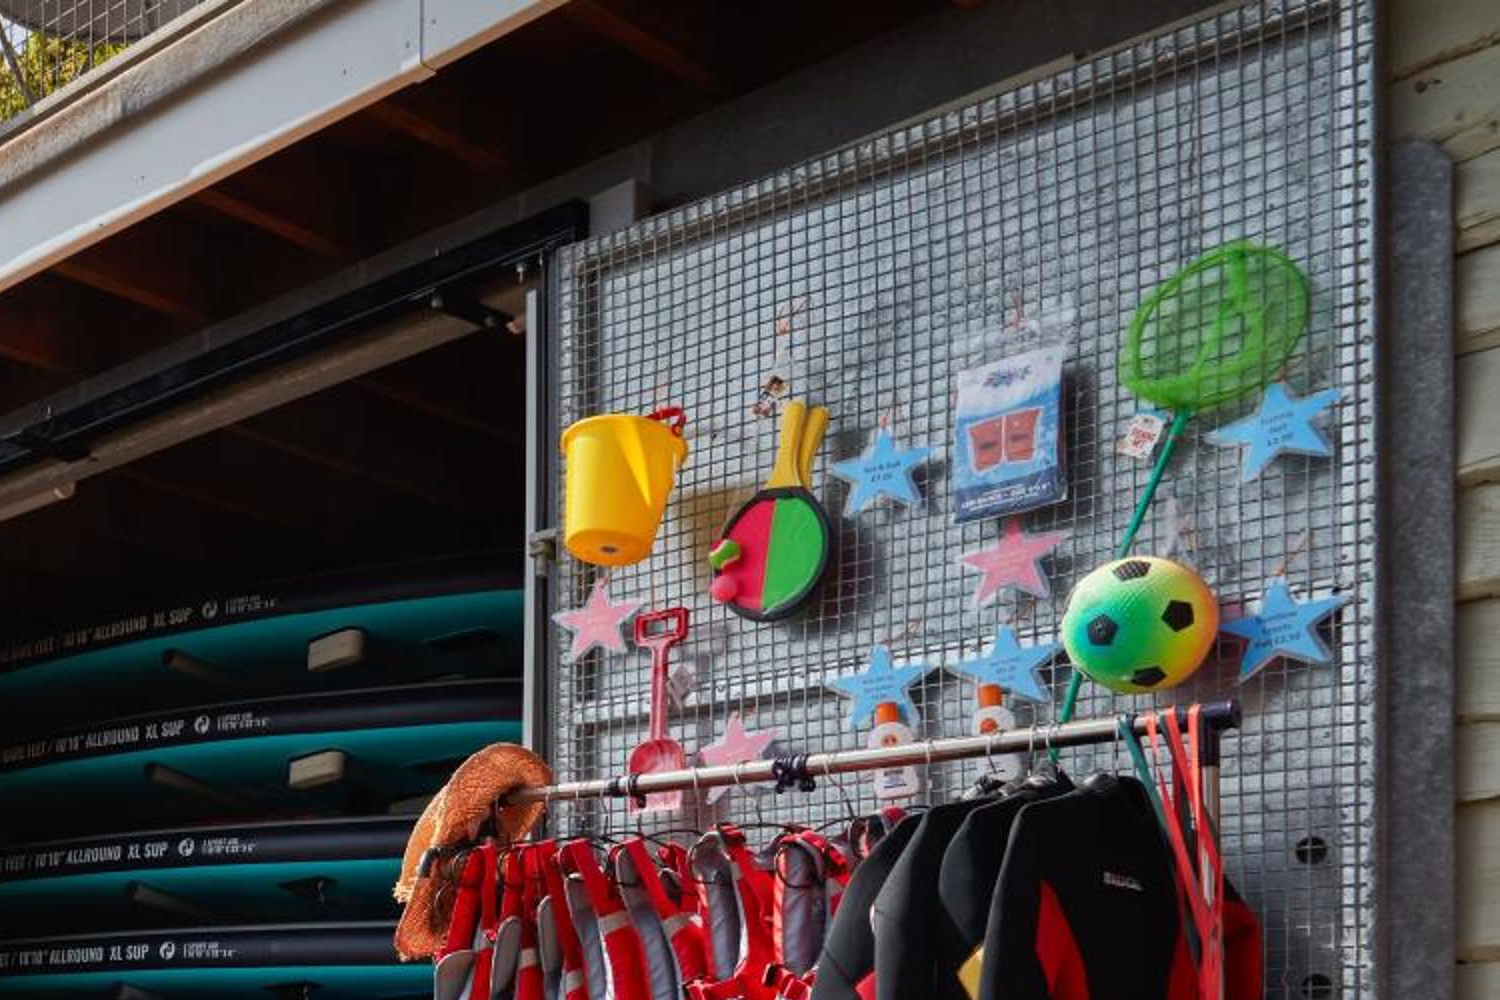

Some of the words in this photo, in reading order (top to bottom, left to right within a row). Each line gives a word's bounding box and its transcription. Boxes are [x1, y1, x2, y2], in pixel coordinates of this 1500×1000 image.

[154, 610, 167, 627] XL
[169, 607, 192, 625] SUP
[84, 726, 140, 750] ALLROUND
[145, 722, 158, 739] XL
[161, 719, 185, 737] SUP
[65, 844, 121, 864] ALLROUND
[128, 843, 141, 860] XL
[144, 841, 169, 858] SUP
[49, 947, 104, 965] ALLROUND
[109, 945, 123, 961] XL
[126, 944, 149, 960] SUP
